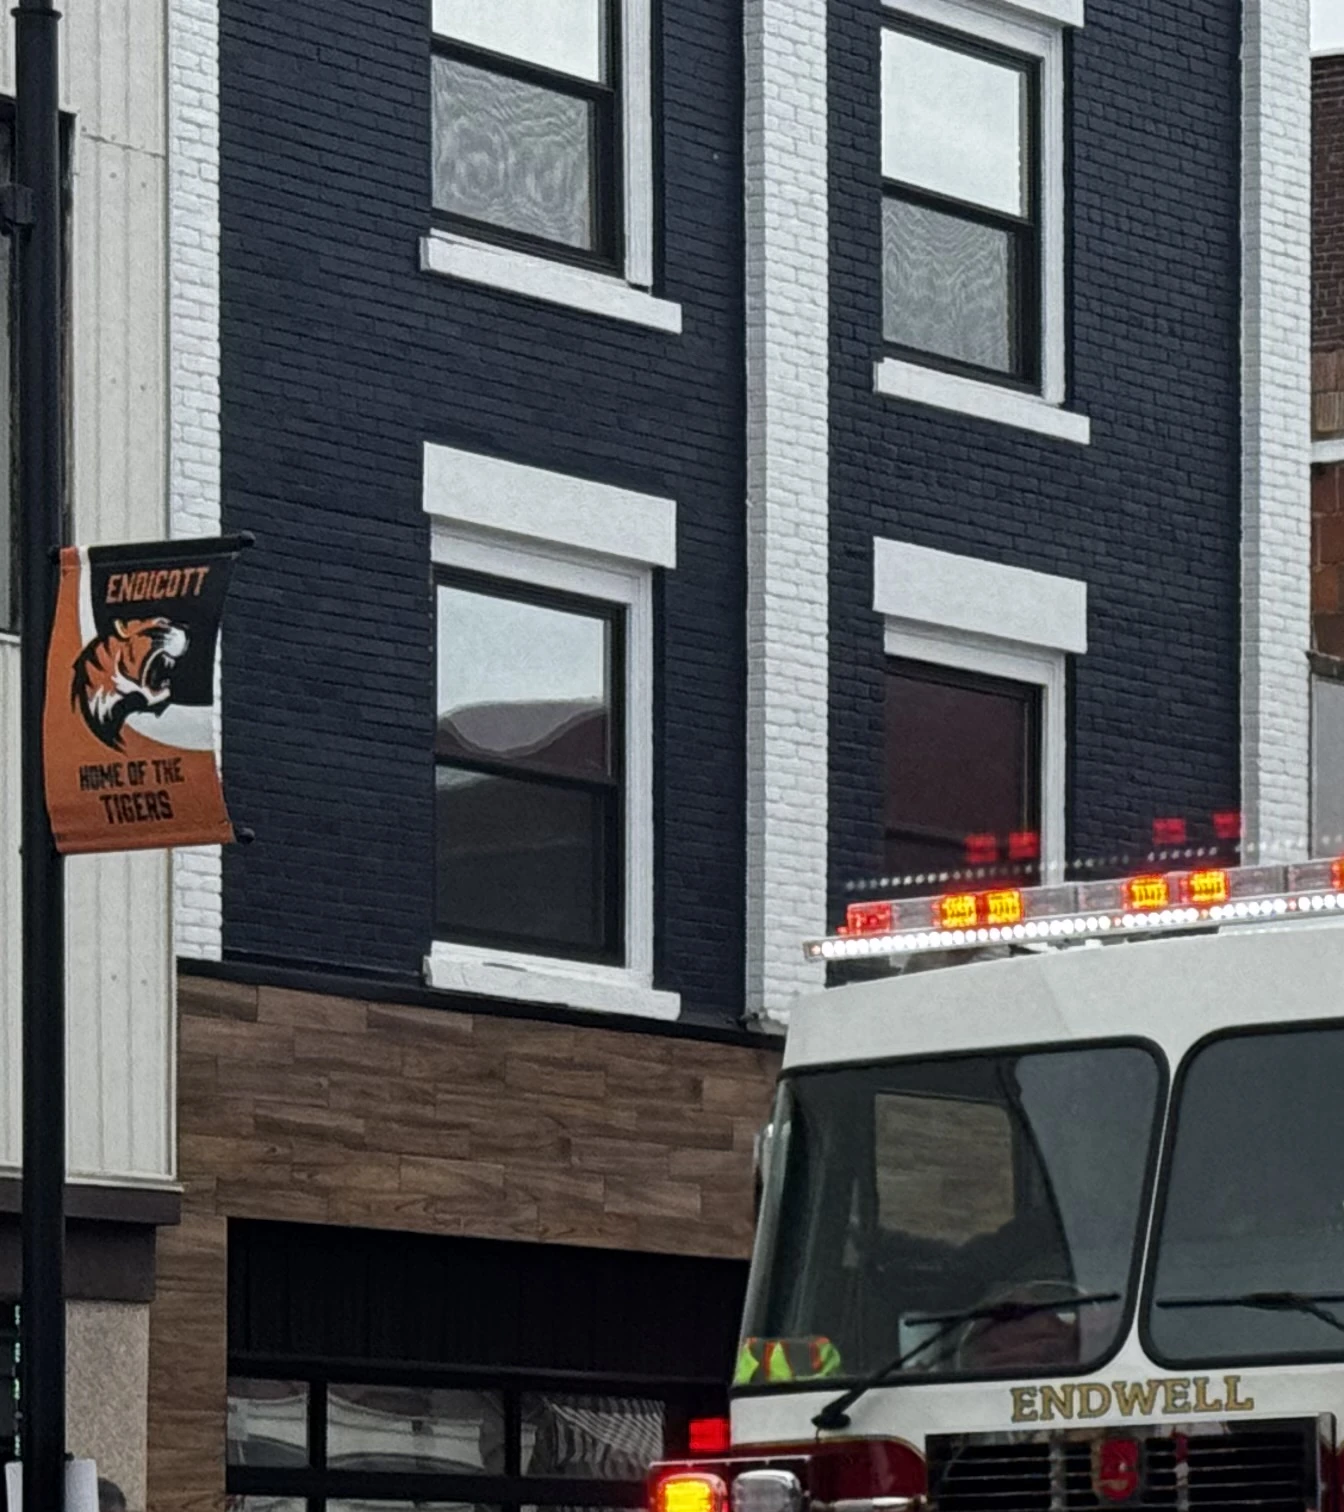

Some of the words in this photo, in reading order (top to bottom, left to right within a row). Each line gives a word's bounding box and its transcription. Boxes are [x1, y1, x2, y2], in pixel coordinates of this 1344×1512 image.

[106, 566, 209, 604] ENDICOTT
[79, 762, 123, 791] HOME
[127, 760, 147, 786] OF
[152, 757, 185, 785] THE
[100, 790, 174, 824] TIGERS
[1010, 1375, 1255, 1423] ENDWELL
